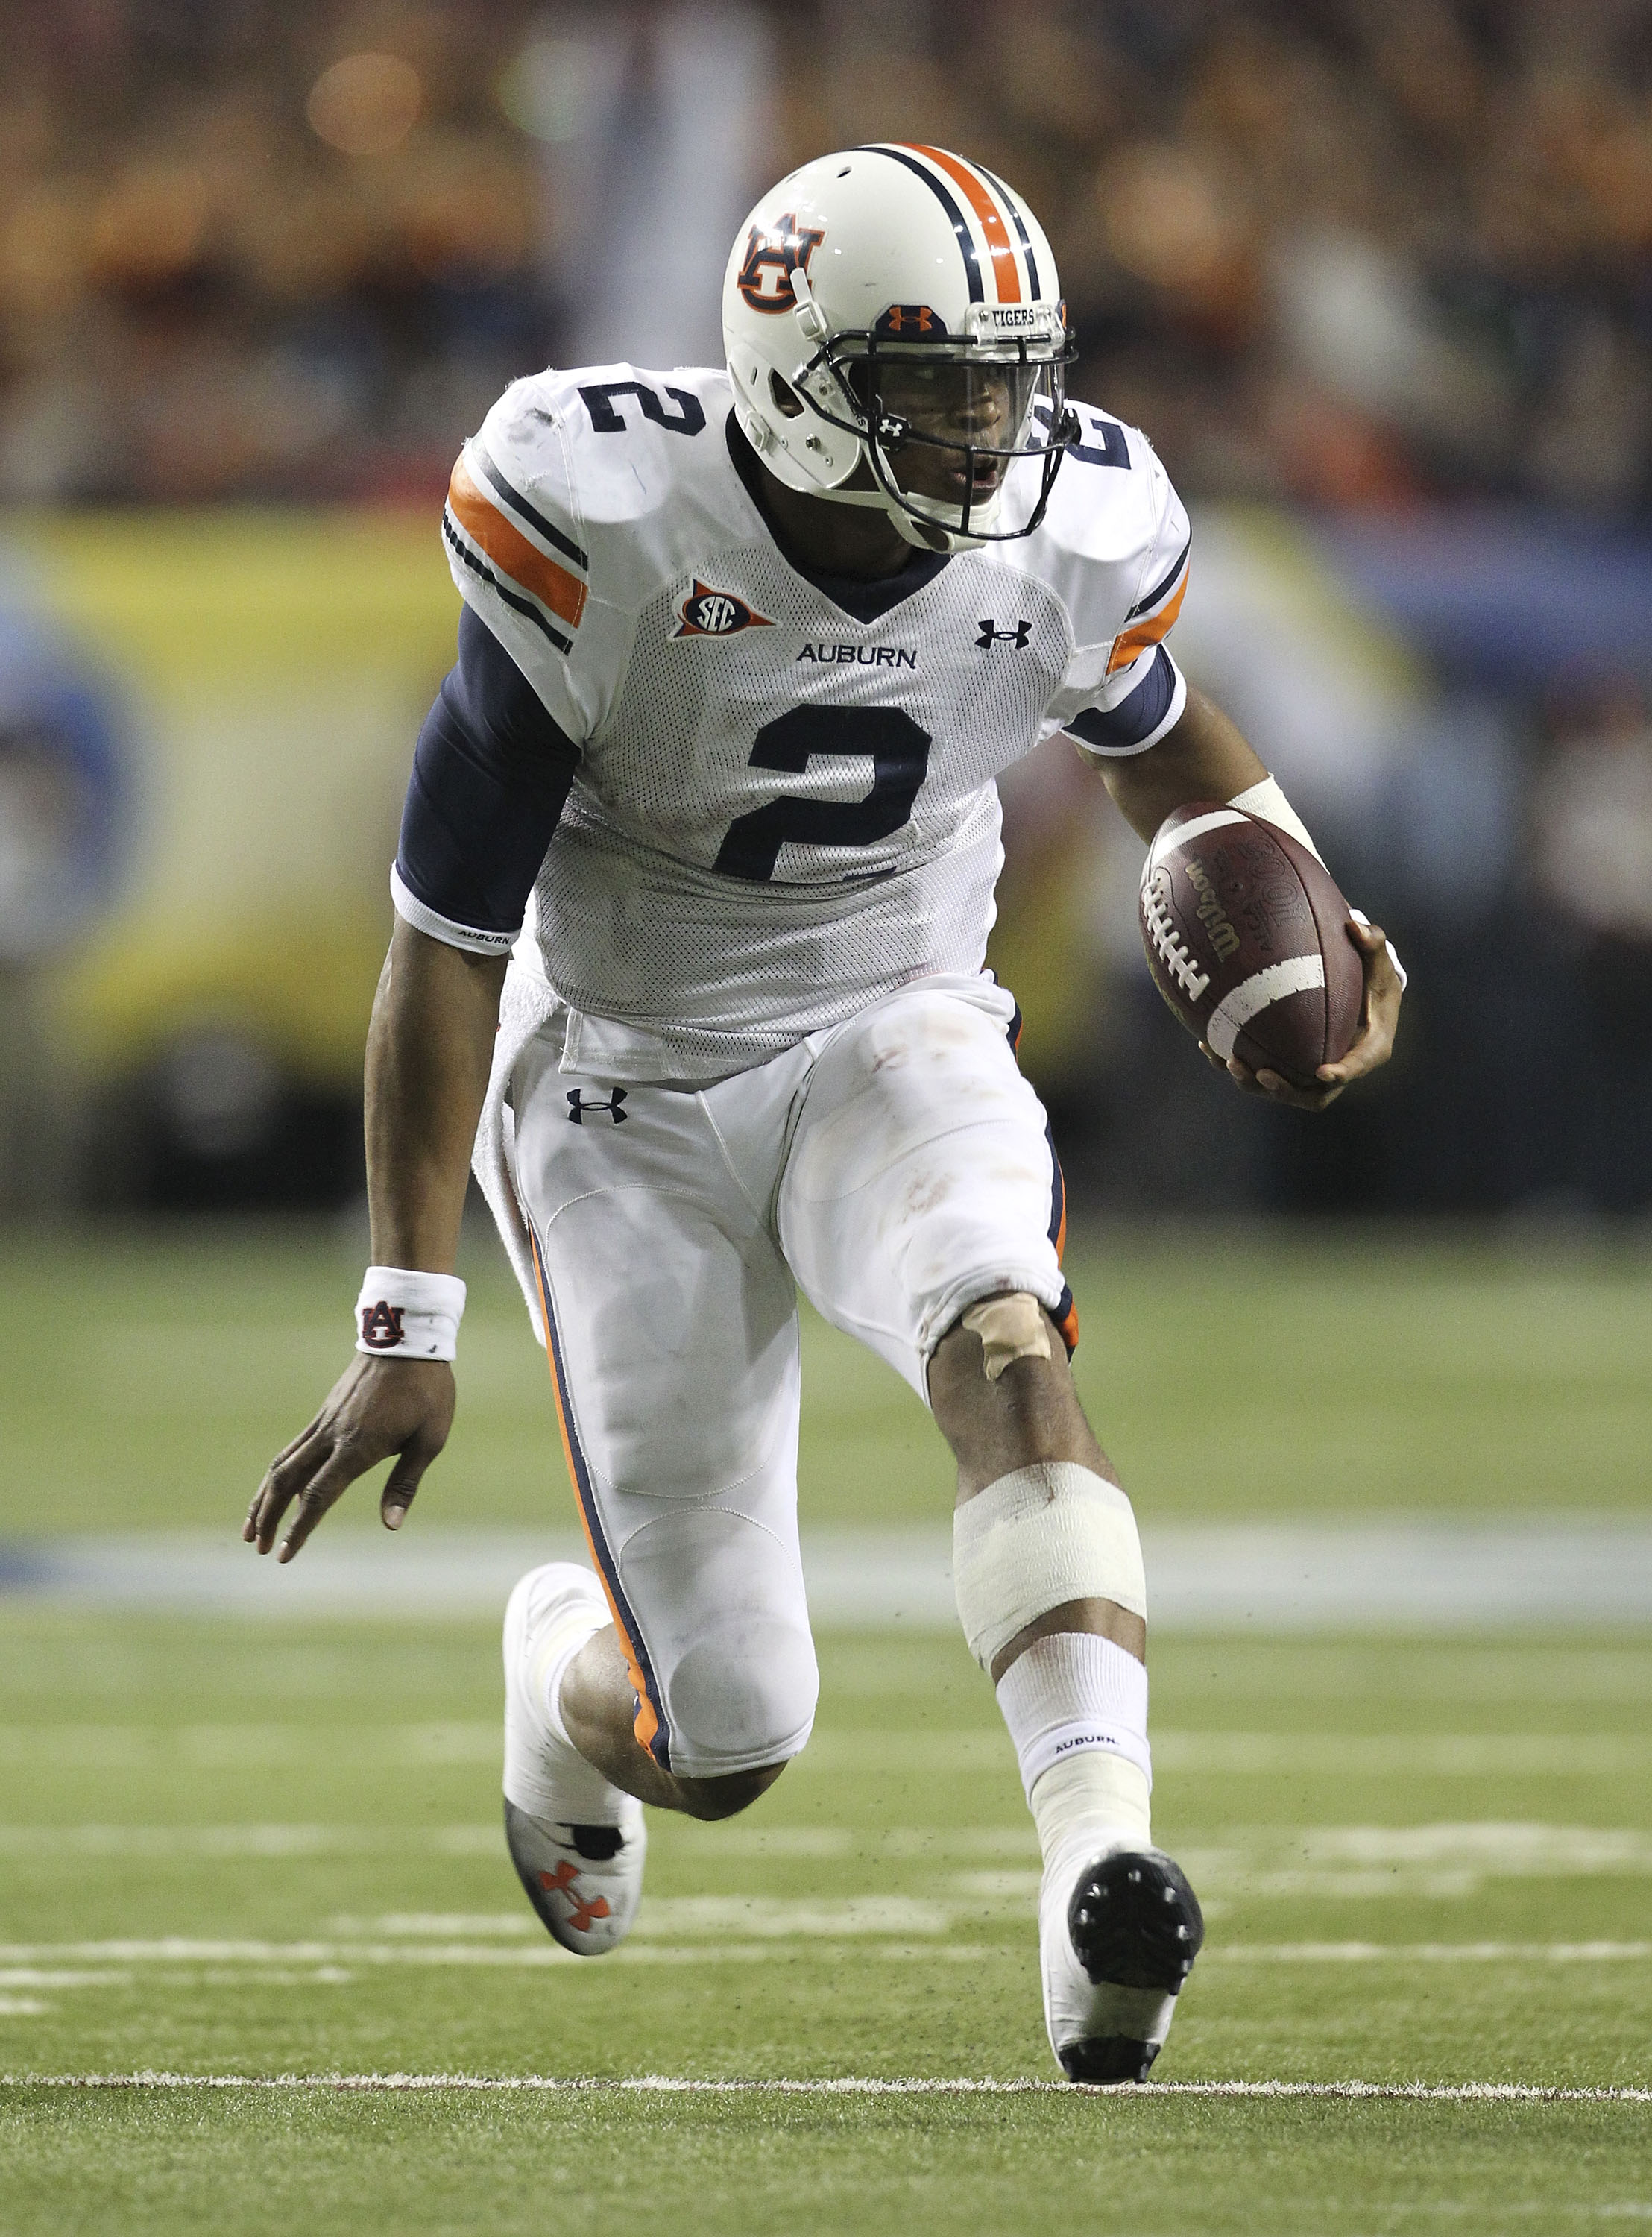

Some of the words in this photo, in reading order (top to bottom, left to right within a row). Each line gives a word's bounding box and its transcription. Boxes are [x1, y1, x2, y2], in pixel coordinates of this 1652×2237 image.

[992, 309, 1035, 327] TIGERS
[577, 381, 707, 436] 2
[697, 596, 736, 632] SEC
[796, 643, 918, 670] AUBURN
[711, 703, 933, 883] 2
[1185, 856, 1240, 963] Wilson
[458, 931, 510, 945] AUBURN
[1056, 1736, 1116, 1754] AUBURN
